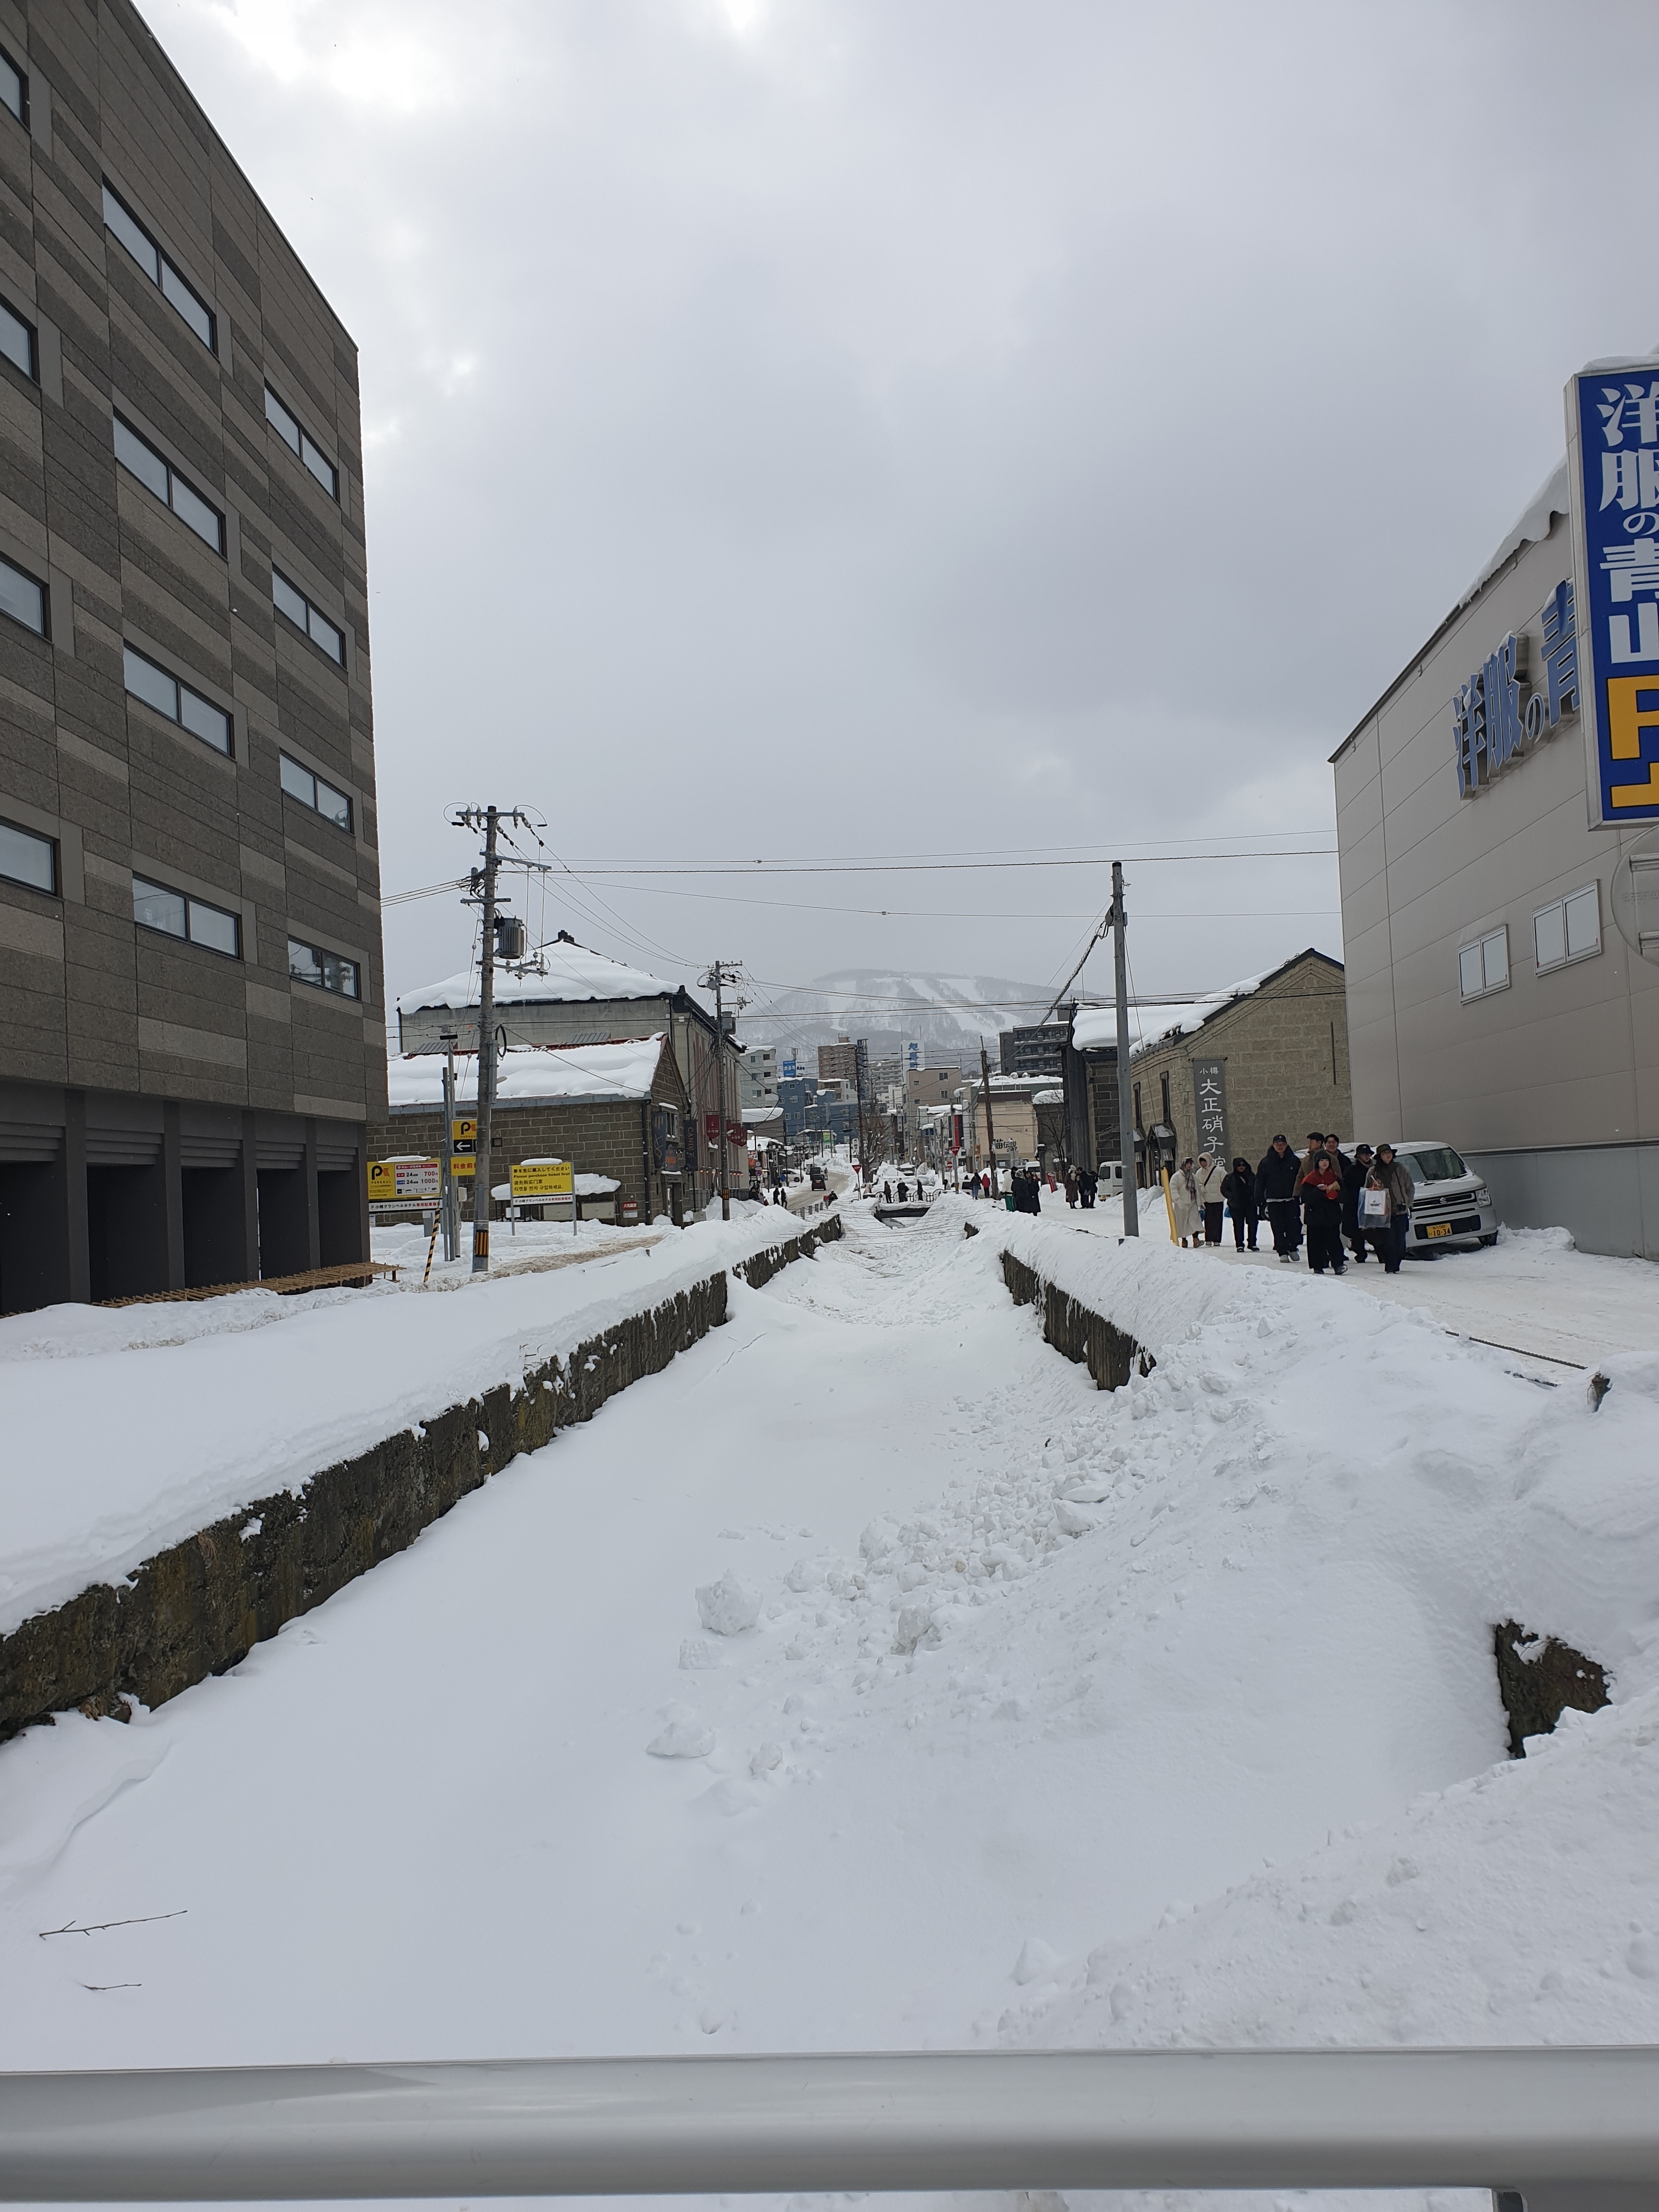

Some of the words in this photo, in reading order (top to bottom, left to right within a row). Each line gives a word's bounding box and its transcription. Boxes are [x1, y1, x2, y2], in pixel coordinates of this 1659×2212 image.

[1596, 381, 1659, 665] 洋服の青山
[1199, 1066, 1219, 1075] 小樽
